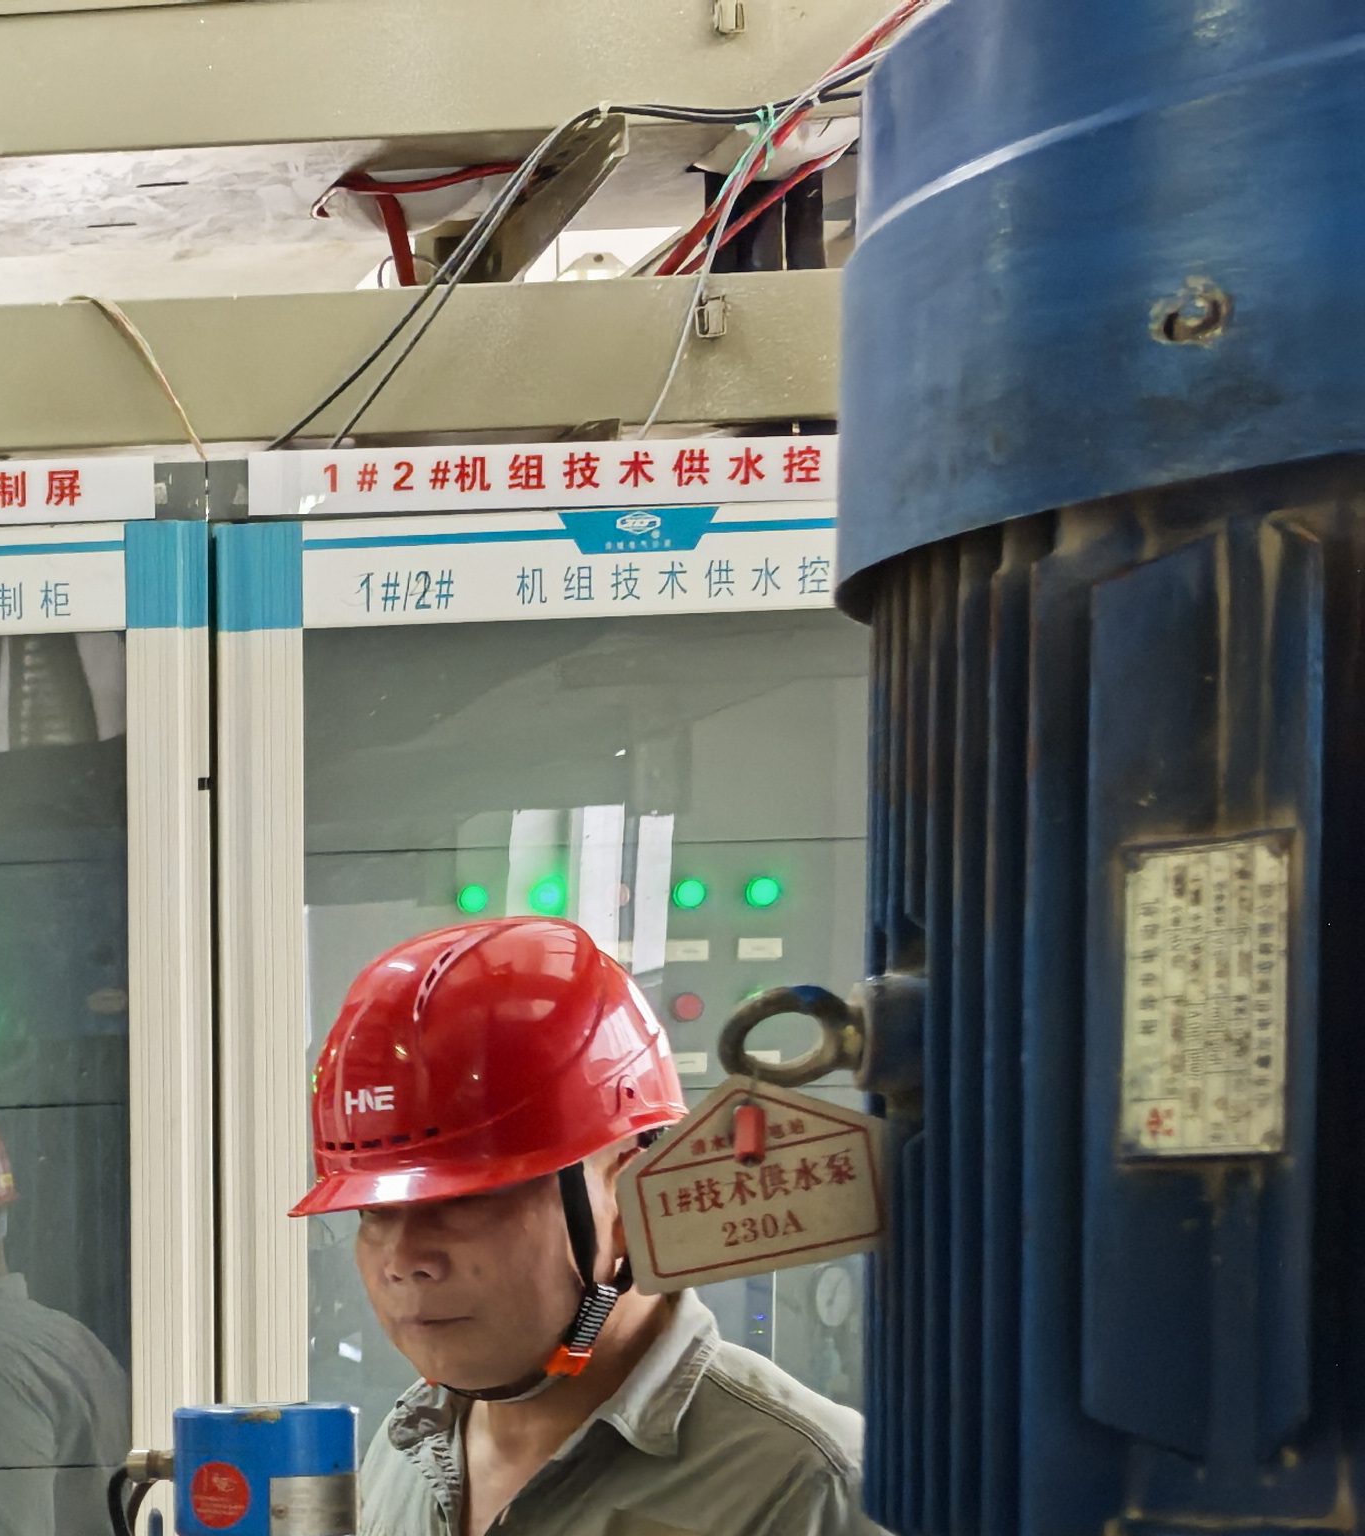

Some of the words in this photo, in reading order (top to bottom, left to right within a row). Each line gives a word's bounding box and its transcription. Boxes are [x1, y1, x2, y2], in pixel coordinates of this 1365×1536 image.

[516, 555, 831, 606] 机组技术供水控
[657, 1148, 857, 1218] 1#技术供水泵
[721, 1209, 808, 1248] 230A
